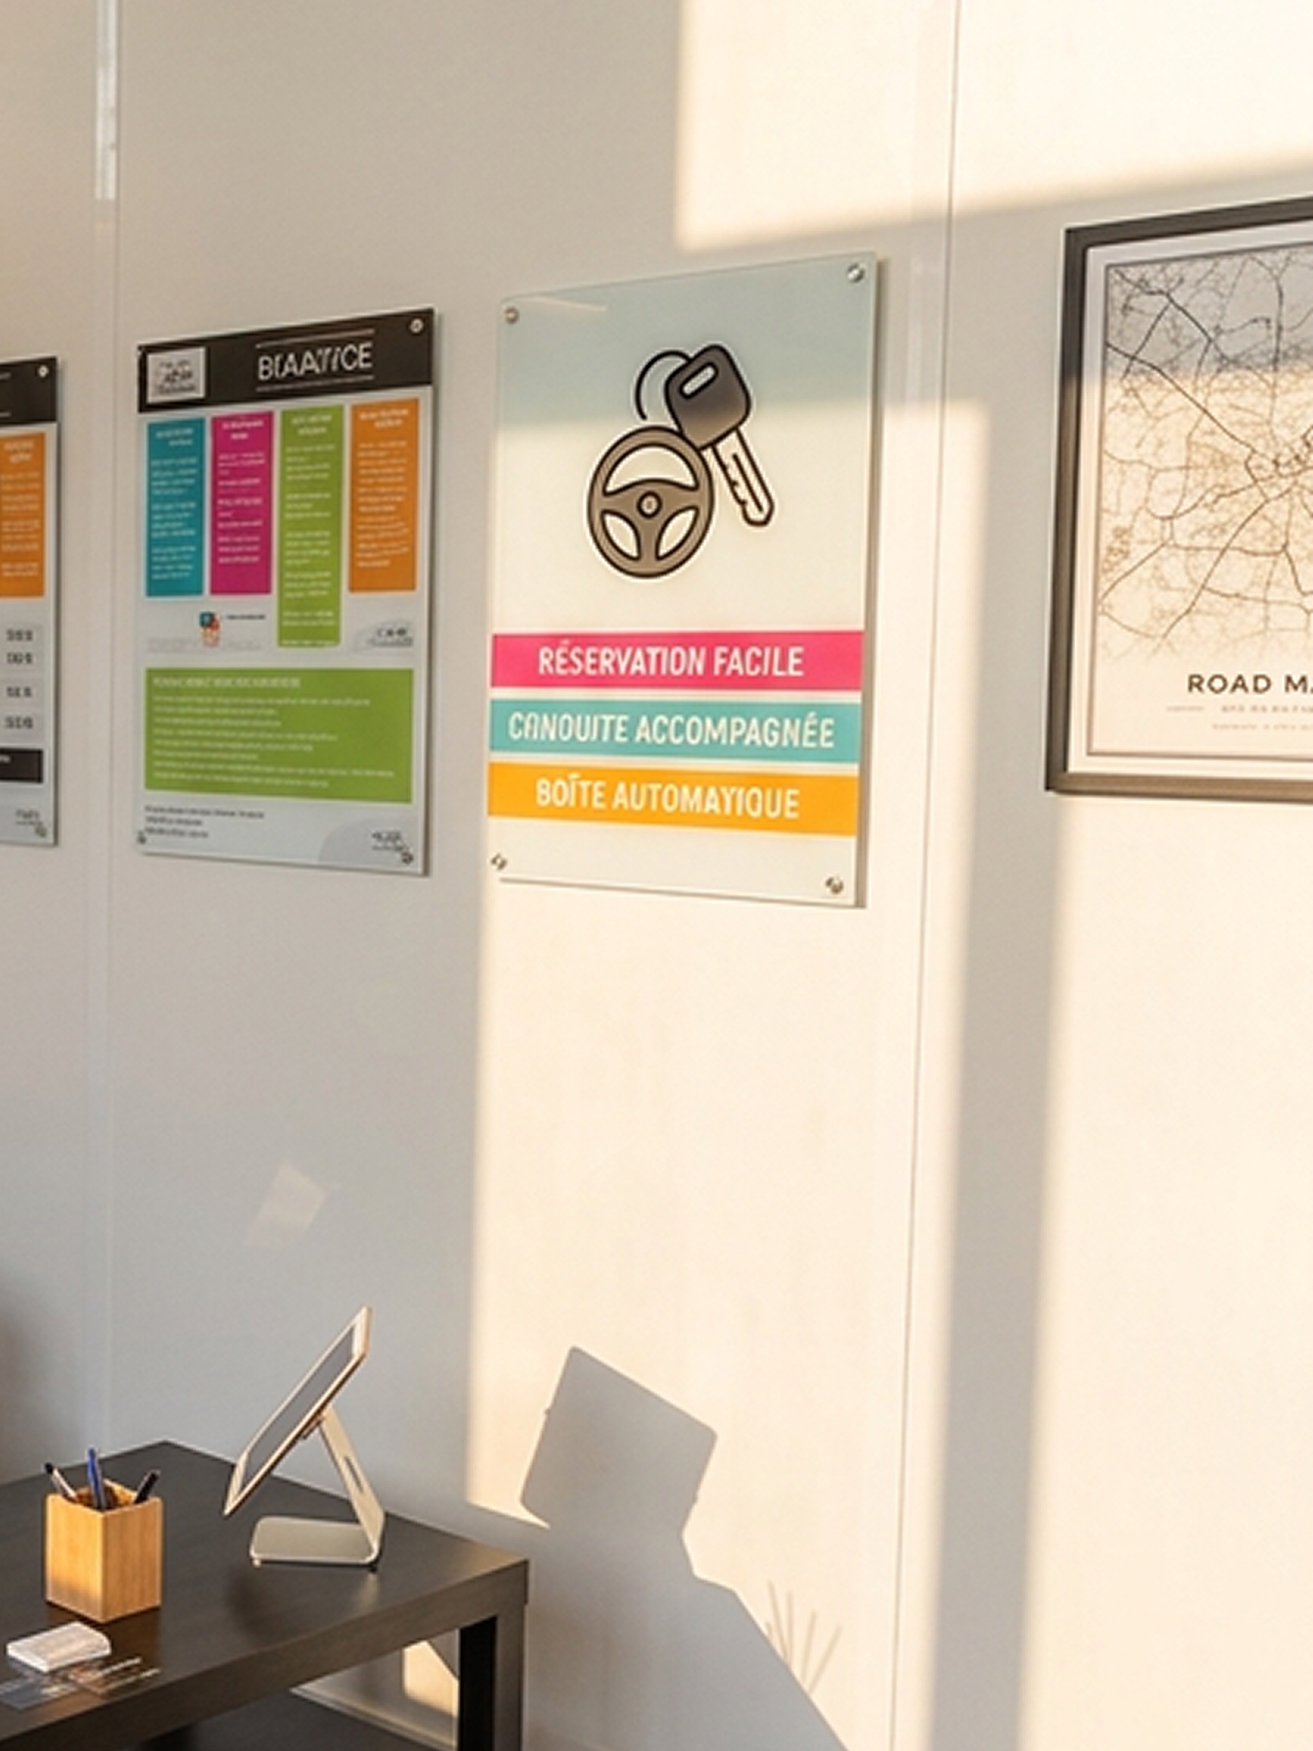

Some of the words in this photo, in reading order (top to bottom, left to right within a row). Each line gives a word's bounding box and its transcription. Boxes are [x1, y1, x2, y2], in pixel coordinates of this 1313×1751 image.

[538, 638, 707, 677] RÉSERVATION
[713, 645, 805, 677] FACILE
[1187, 673, 1272, 694] ROAD
[1284, 673, 1313, 694] M
[635, 711, 835, 748] ACCOMPAGNÉE
[536, 771, 607, 809] BOÎTE
